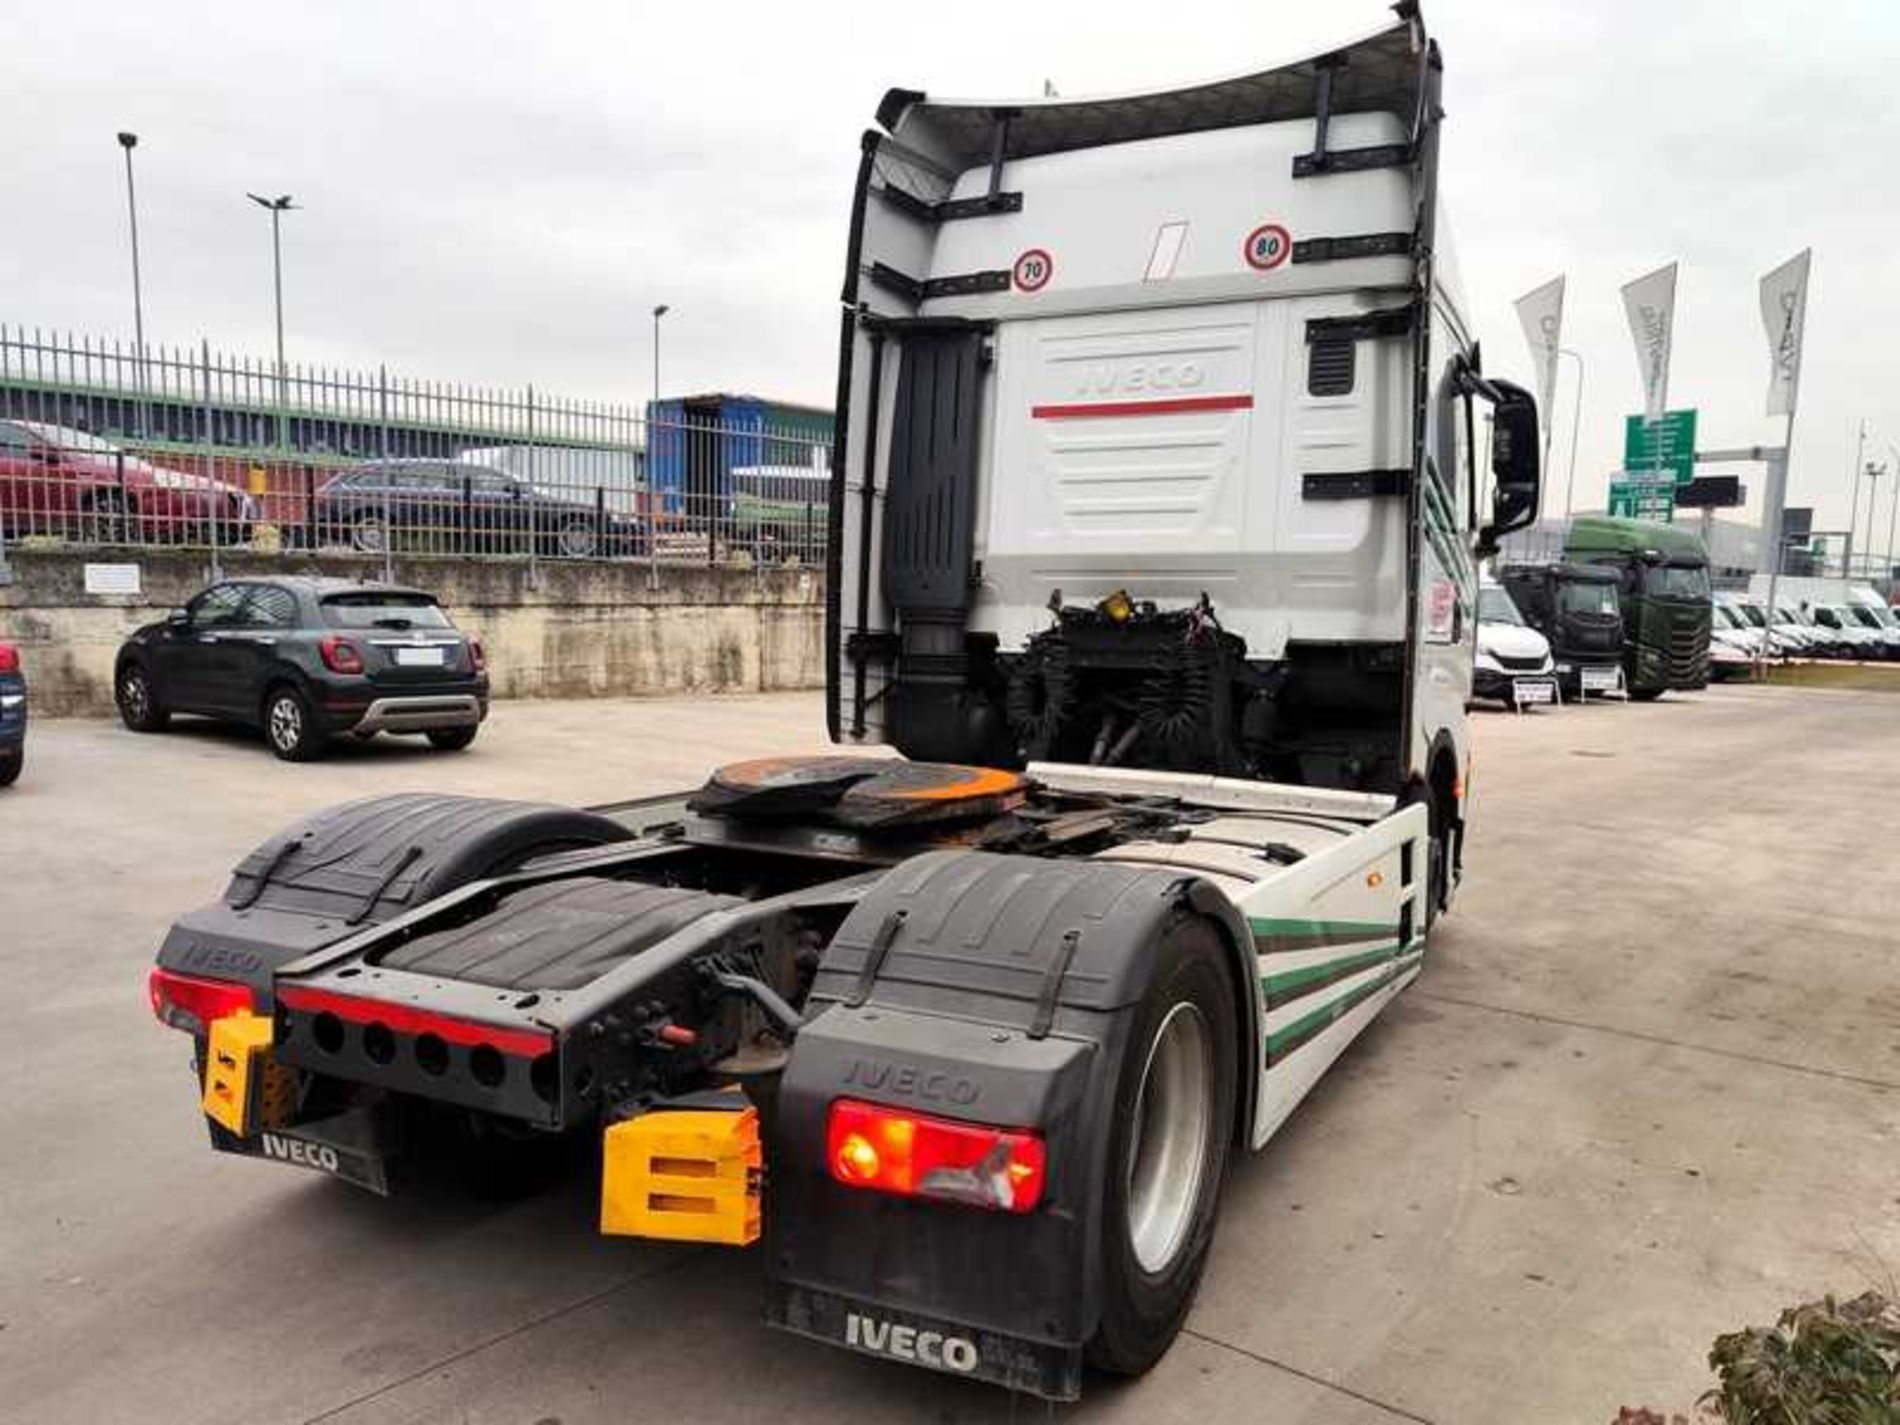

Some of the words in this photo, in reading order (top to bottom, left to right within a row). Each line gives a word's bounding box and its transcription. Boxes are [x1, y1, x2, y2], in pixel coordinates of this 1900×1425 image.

[1256, 236, 1279, 256] 80
[1025, 262, 1043, 279] 70
[1075, 363, 1206, 395] IVECO
[181, 941, 264, 973] IVECO
[843, 1060, 981, 1105] IVECO
[262, 1132, 338, 1171] IVECO
[846, 1312, 977, 1372] IVECO
